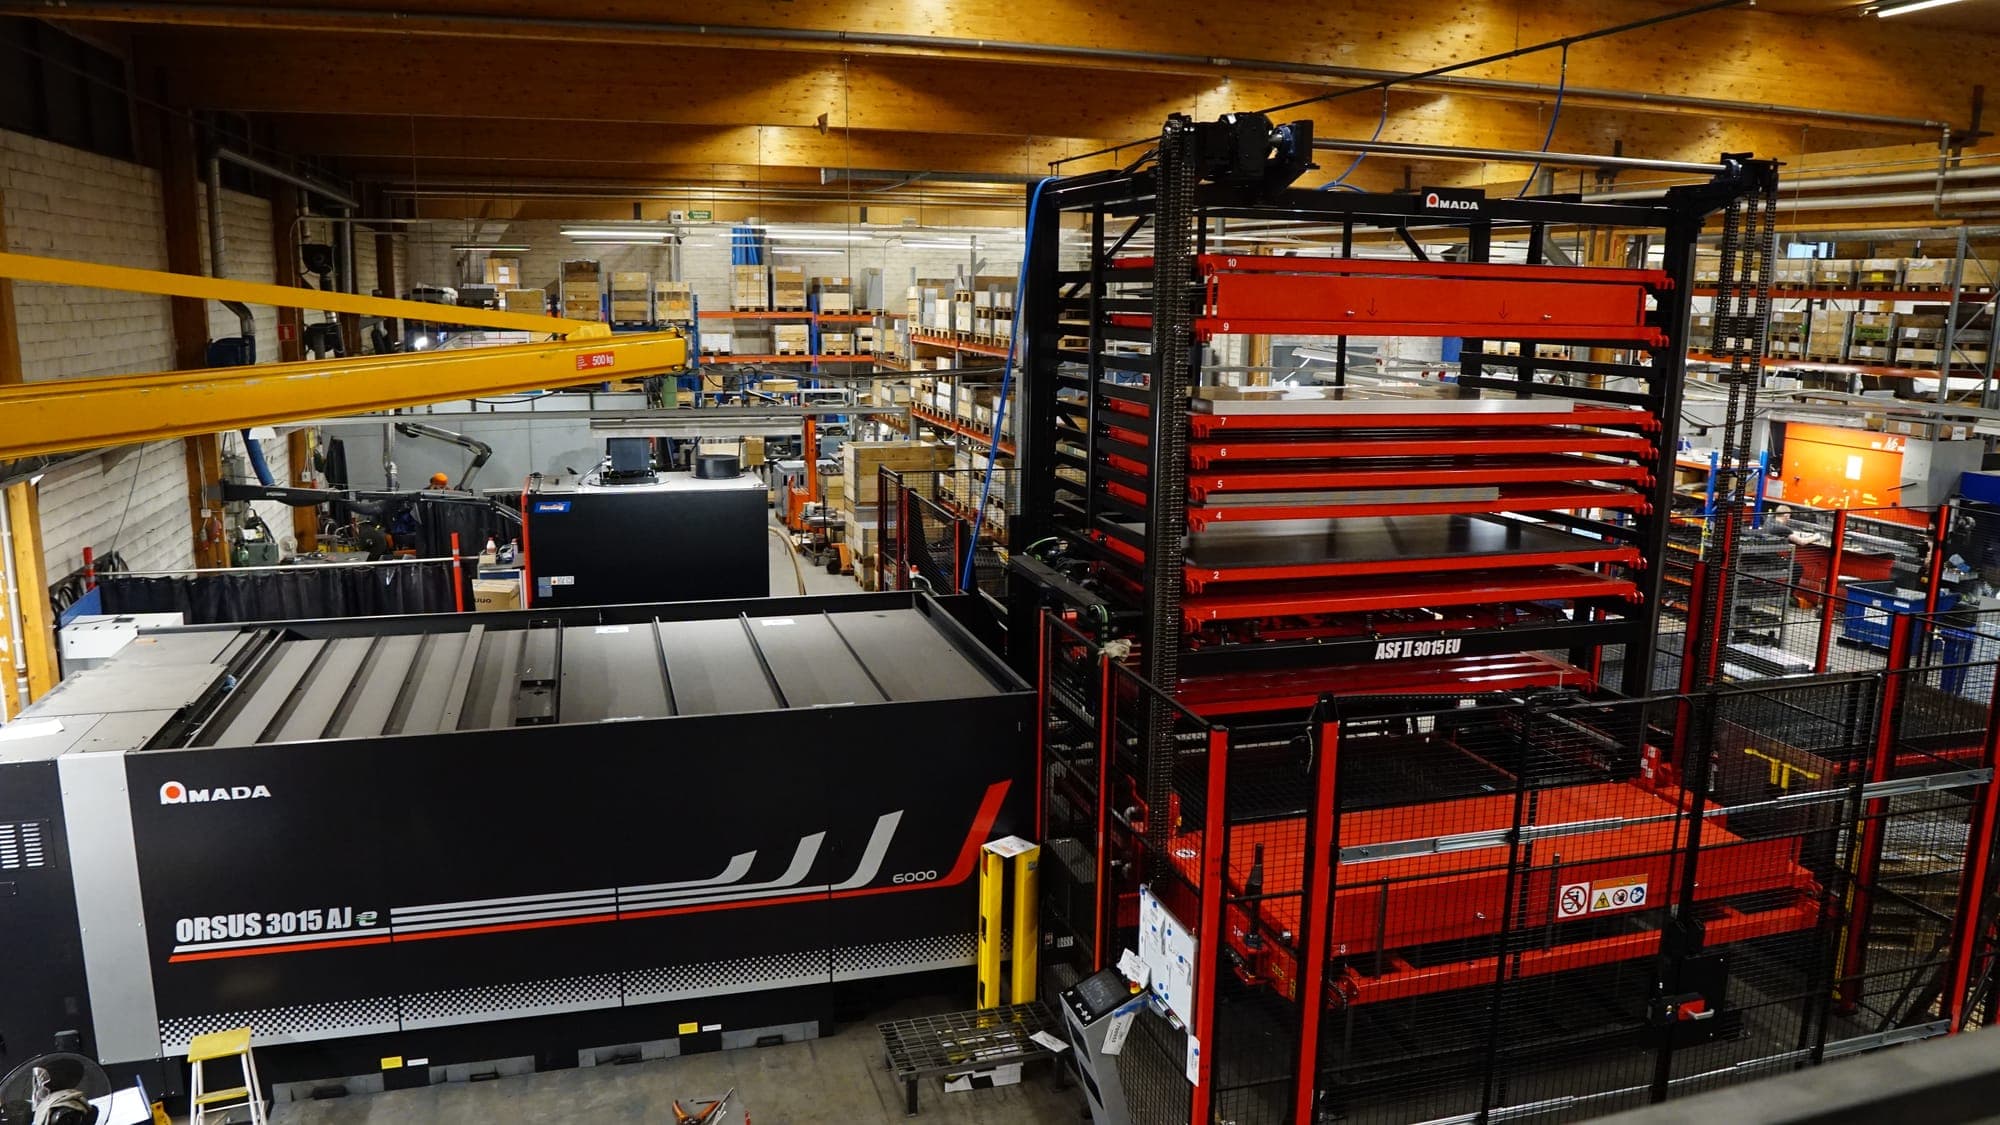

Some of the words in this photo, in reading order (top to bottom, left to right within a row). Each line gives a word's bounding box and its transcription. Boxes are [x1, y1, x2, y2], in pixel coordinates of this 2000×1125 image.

[1426, 192, 1480, 210] AMADA
[1228, 258, 1237, 268] 10
[1223, 322, 1230, 332] 9
[592, 354, 606, 366] 500
[606, 354, 614, 366] kg
[1220, 417, 1227, 426] 7
[1220, 448, 1227, 457] 6
[1217, 480, 1224, 489] 5
[1215, 511, 1222, 520] 4
[1213, 570, 1220, 580] 2
[1210, 610, 1217, 619] 1
[1375, 642, 1402, 660] ASF
[160, 780, 272, 805] AMADA
[892, 870, 937, 884] 6000
[176, 912, 263, 943] ORSUS
[266, 909, 324, 935] 3015
[326, 906, 353, 930] AJ
[1340, 944, 1346, 954] 8
